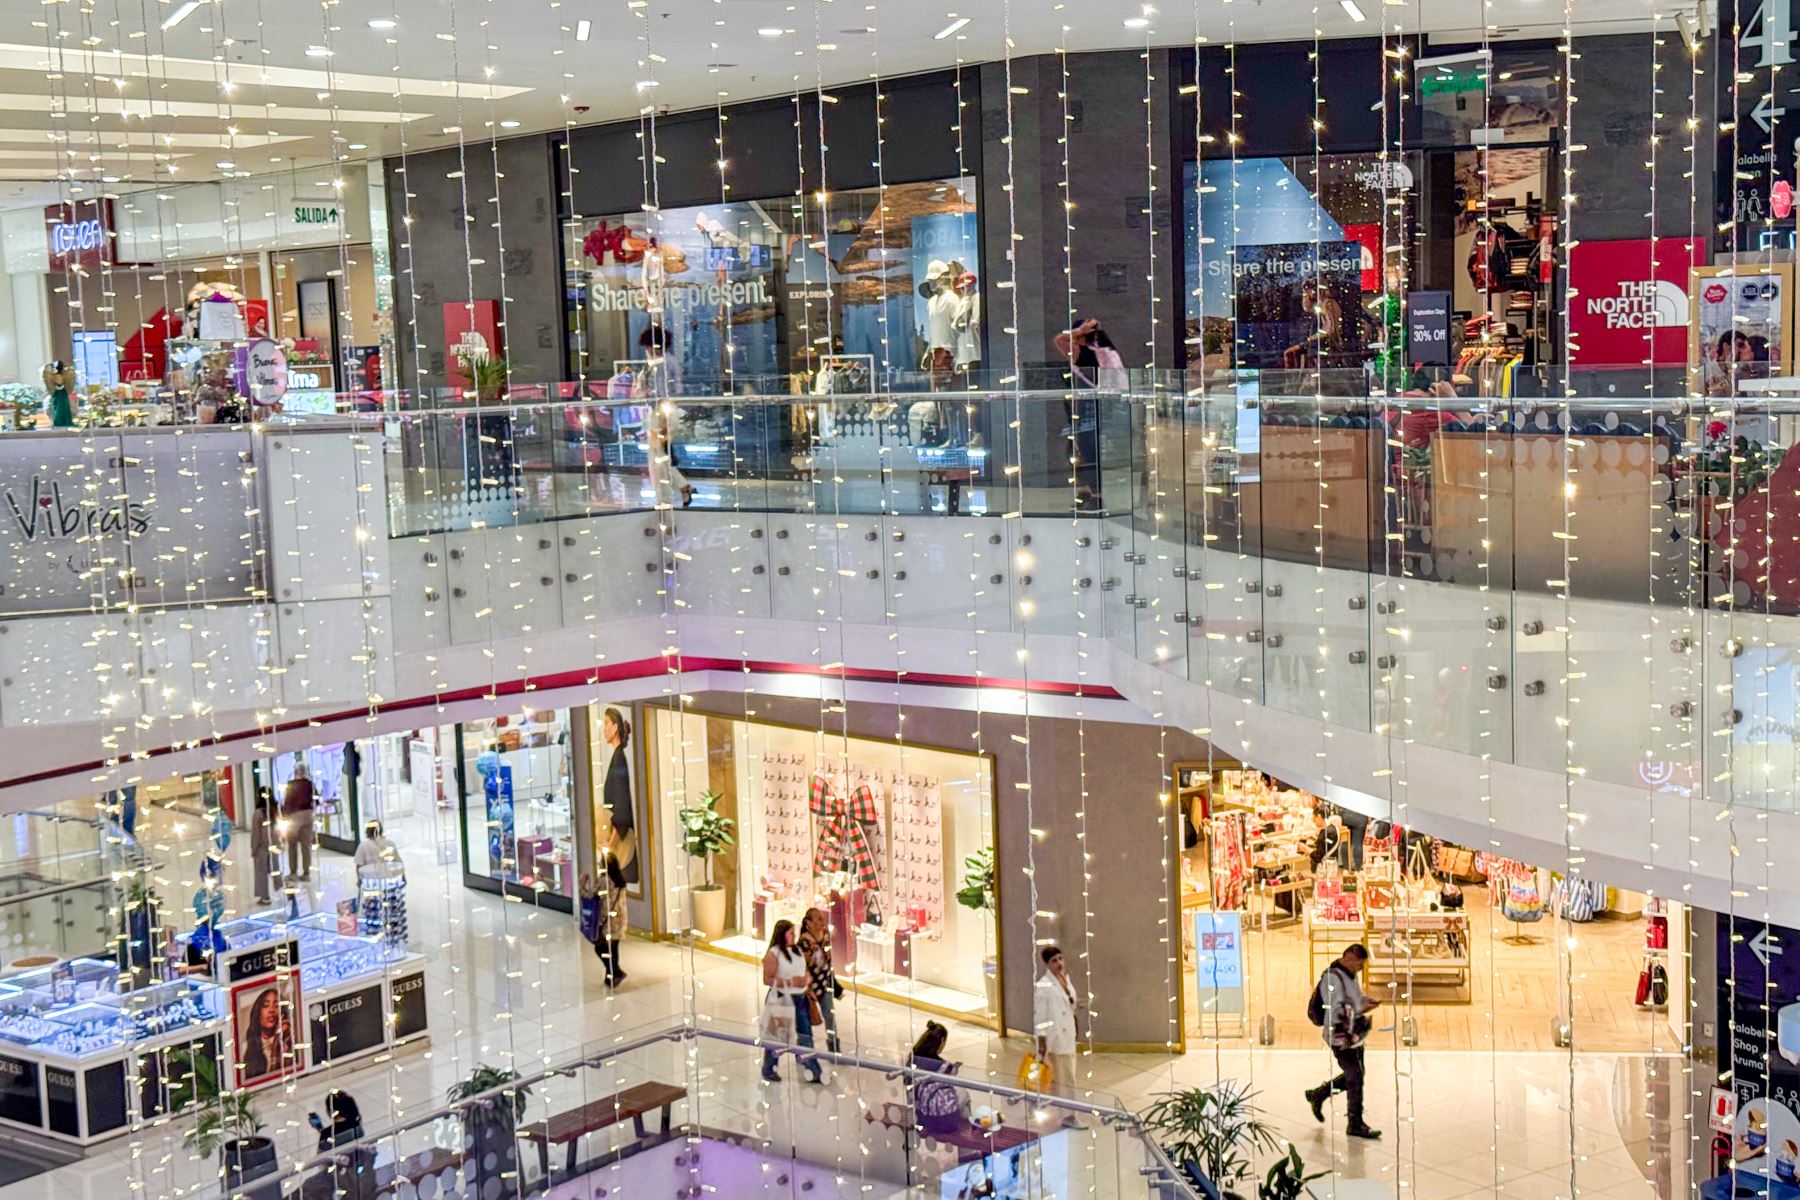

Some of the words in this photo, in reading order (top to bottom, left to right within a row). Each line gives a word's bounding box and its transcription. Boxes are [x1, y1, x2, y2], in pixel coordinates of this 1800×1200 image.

[1739, 0, 1798, 68] 4
[1371, 162, 1392, 172] THE
[1737, 152, 1777, 166] alabella
[1355, 171, 1392, 182] NORTH
[1365, 179, 1392, 190] FACE
[294, 207, 328, 224] SALIDA
[1208, 259, 1261, 277] Share
[1265, 257, 1296, 274] the
[592, 283, 647, 312] Share
[688, 275, 773, 312] present.
[1617, 281, 1655, 297] THE
[1587, 297, 1655, 315] NORTH
[1607, 312, 1655, 330] FACE
[1413, 330, 1432, 342] 30%
[1433, 329, 1446, 341] Off
[6, 476, 152, 539] Vibras
[242, 952, 287, 973] GUESS
[392, 978, 423, 995] GUESS
[330, 996, 363, 1015] GUESS
[1734, 1037, 1759, 1055] Shop
